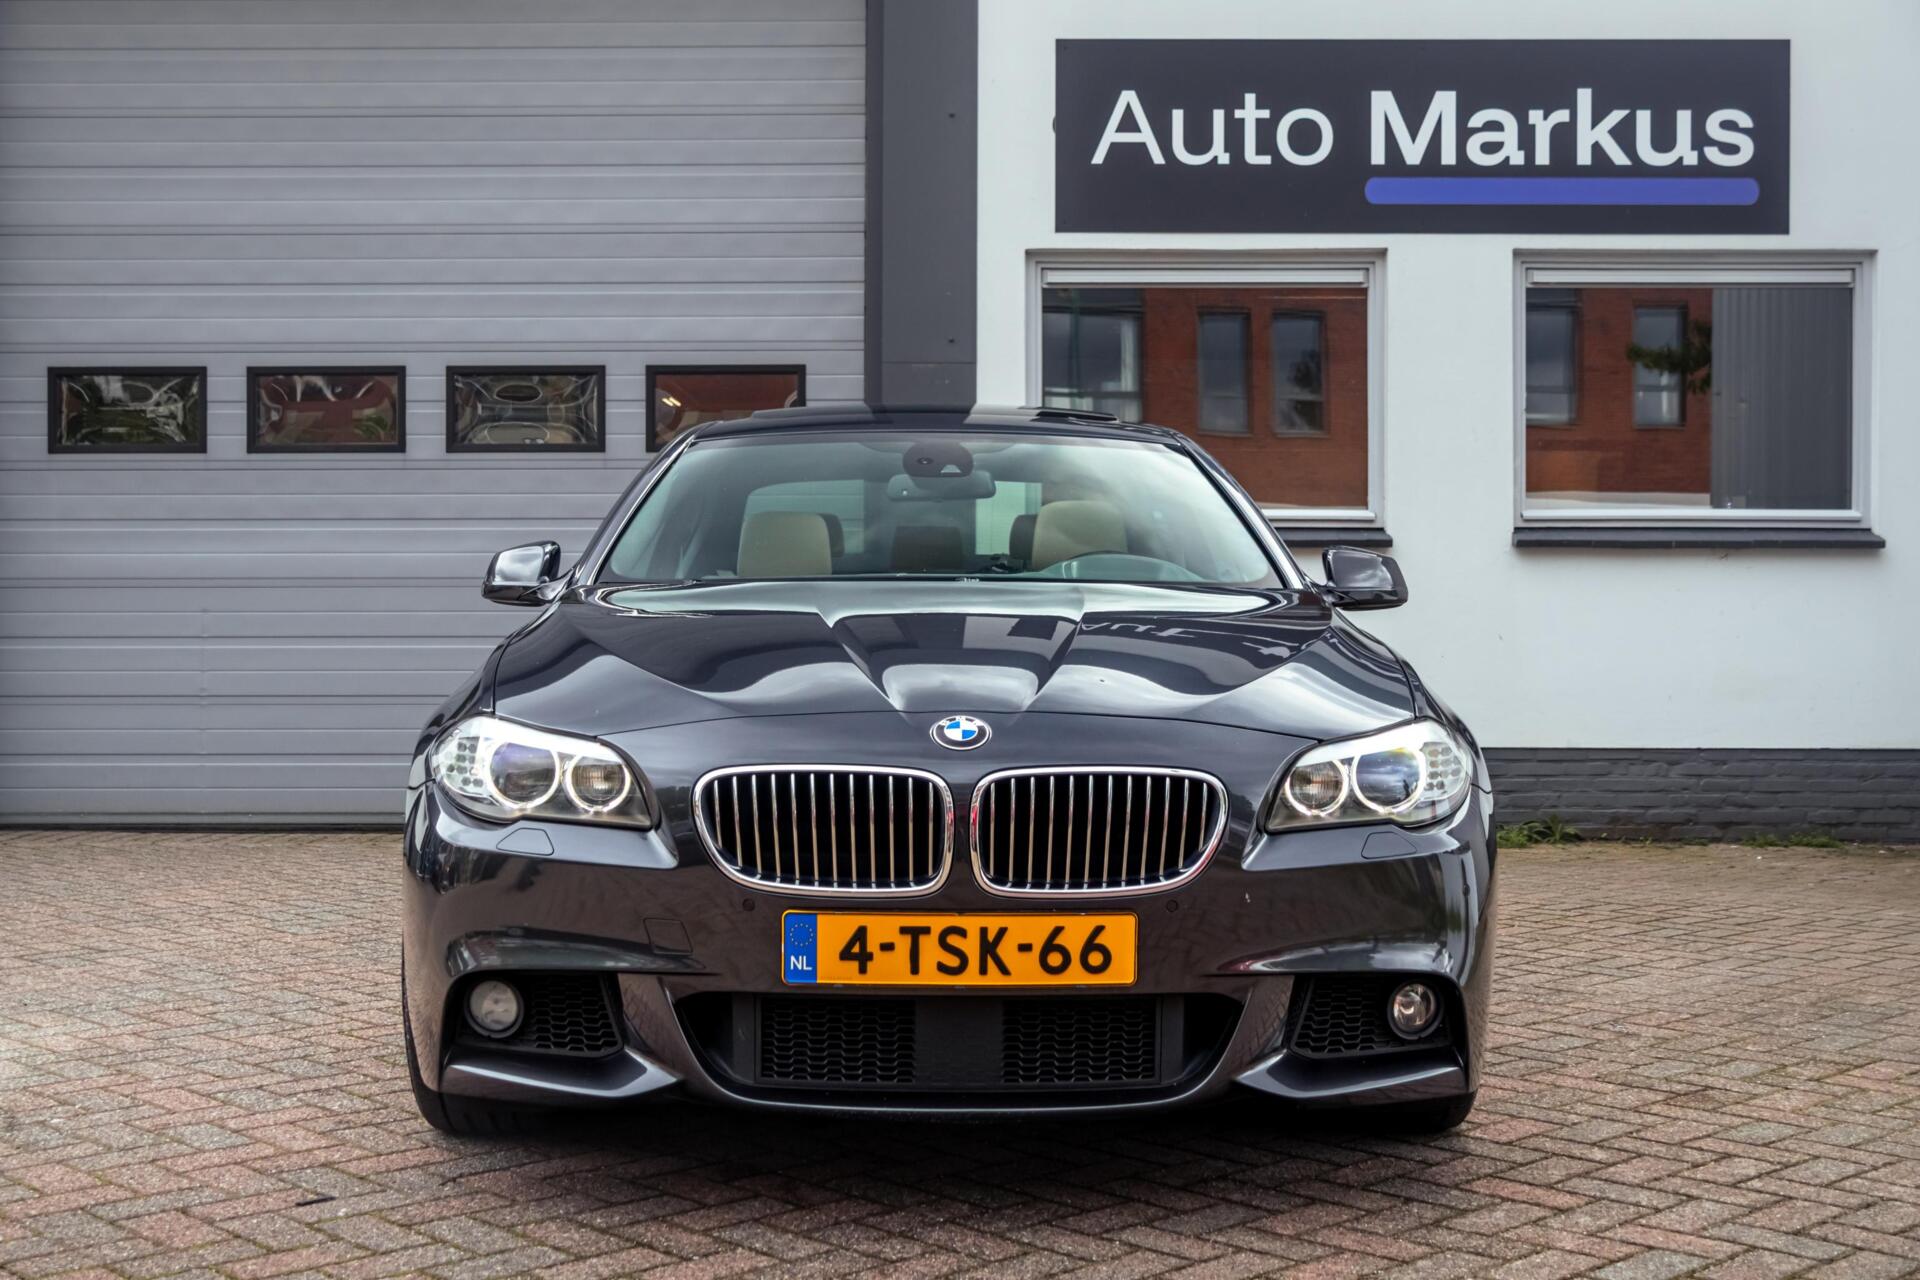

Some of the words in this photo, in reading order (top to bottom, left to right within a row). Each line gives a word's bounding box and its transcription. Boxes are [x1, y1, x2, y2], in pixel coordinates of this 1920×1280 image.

[1091, 90, 1333, 165] Auto
[1370, 88, 1754, 166] Markus
[790, 955, 812, 971] NL
[838, 924, 1113, 976] 4-TSK-66
